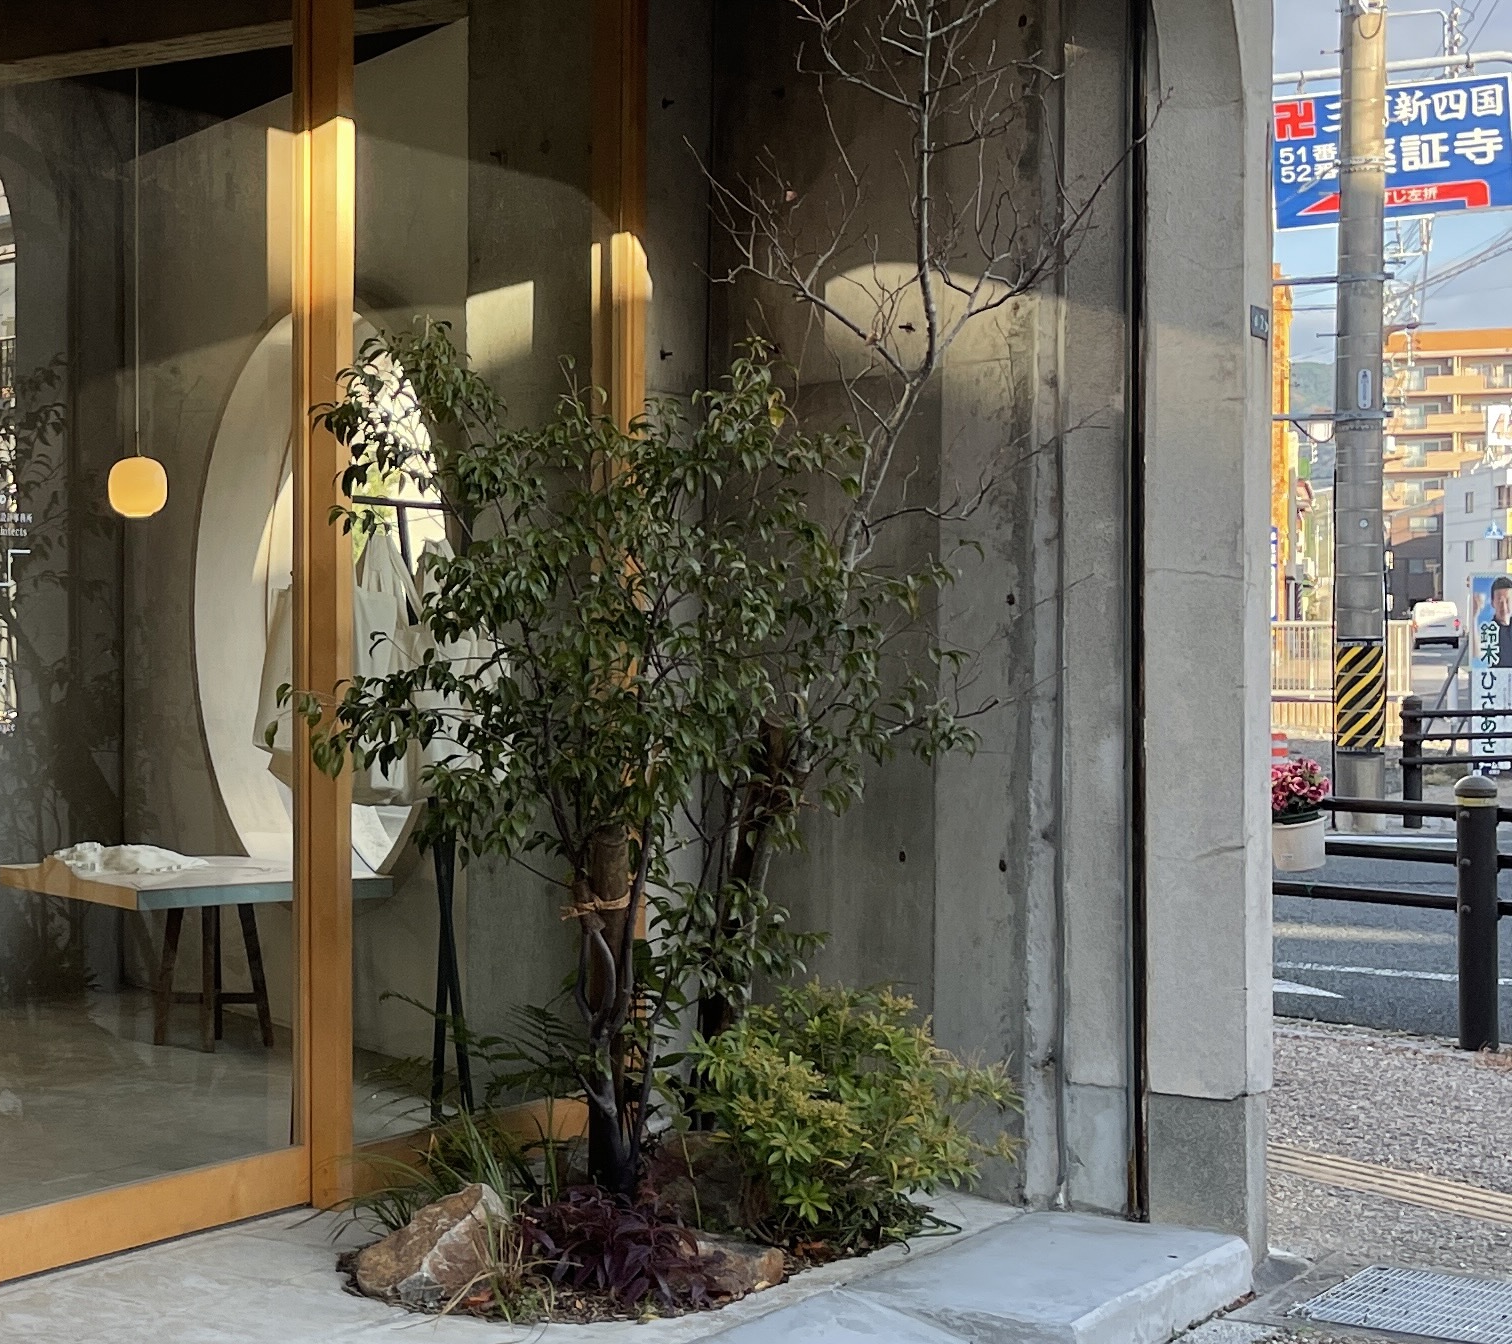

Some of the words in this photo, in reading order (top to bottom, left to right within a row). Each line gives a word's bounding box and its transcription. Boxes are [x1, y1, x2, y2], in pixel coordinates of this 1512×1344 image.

[1322, 84, 1504, 132] 三新四国
[1279, 142, 1338, 165] 51番
[1280, 162, 1339, 184] 52番
